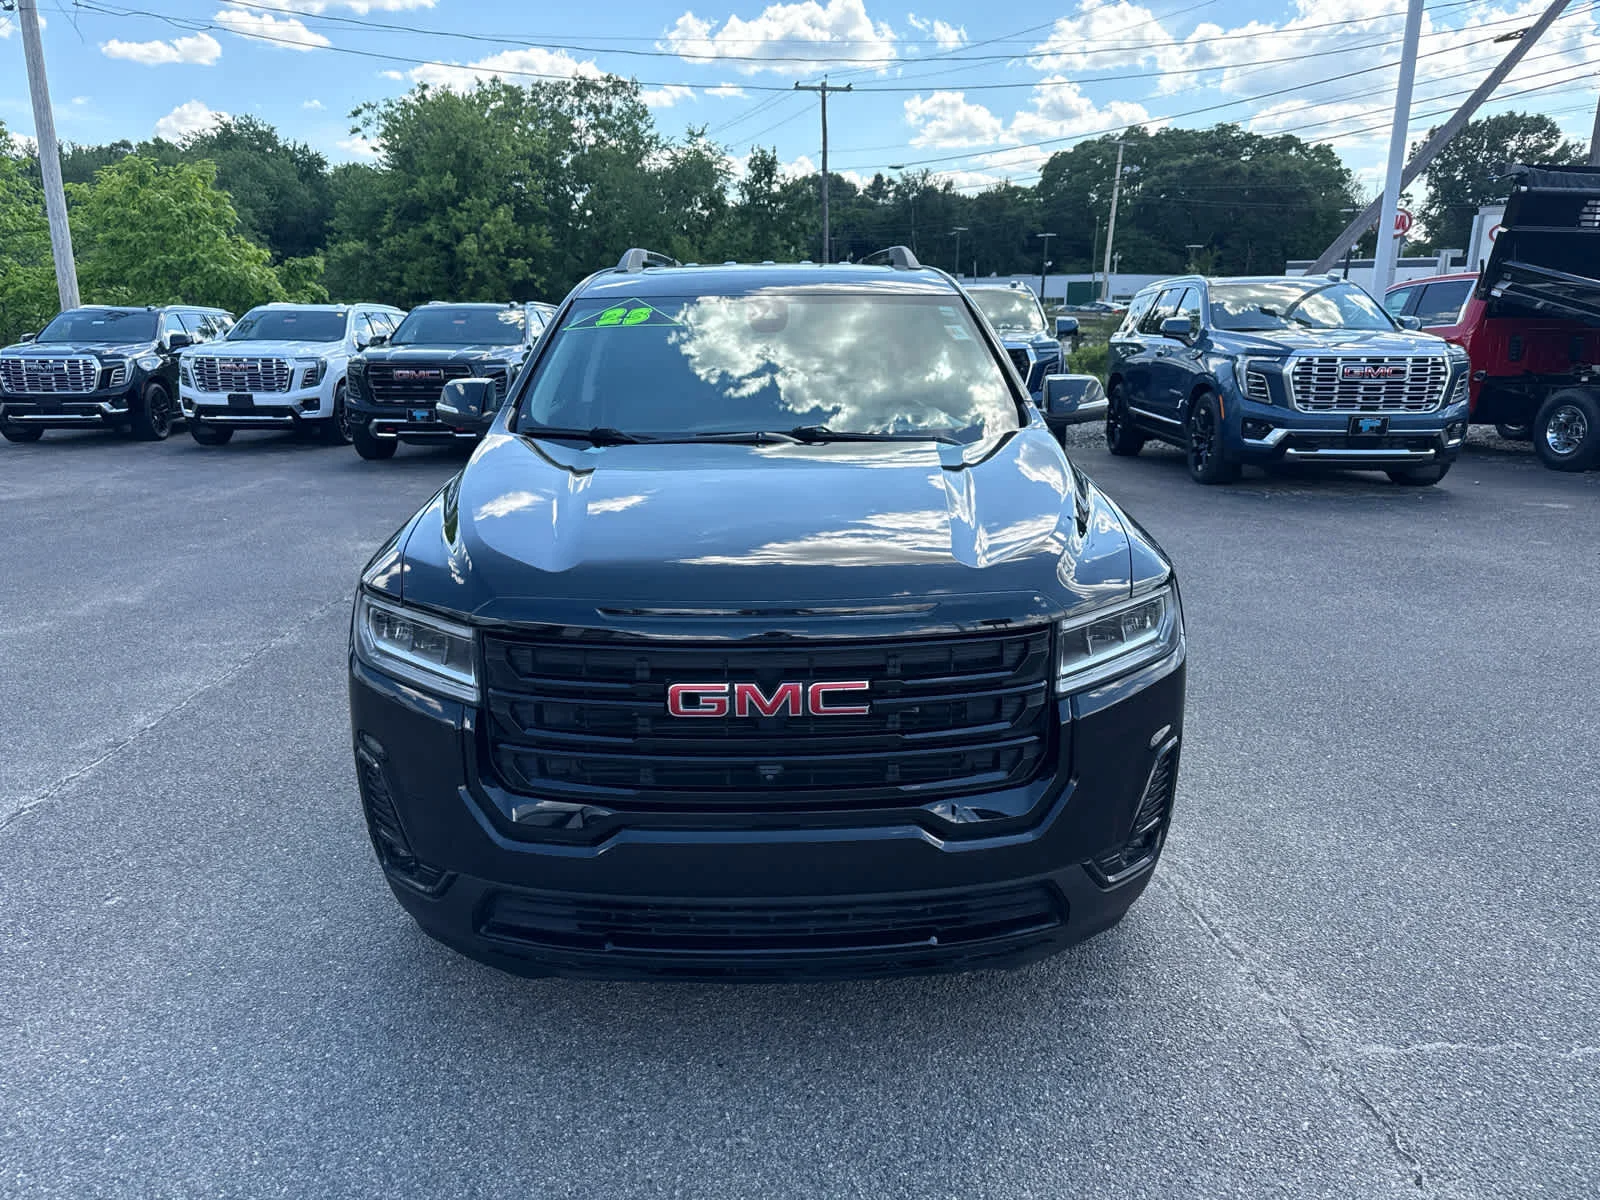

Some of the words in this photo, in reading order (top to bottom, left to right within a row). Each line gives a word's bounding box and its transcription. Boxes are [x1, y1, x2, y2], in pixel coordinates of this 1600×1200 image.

[394, 369, 441, 380] GMC
[1343, 366, 1407, 378] GMC
[667, 680, 870, 717] GMC
